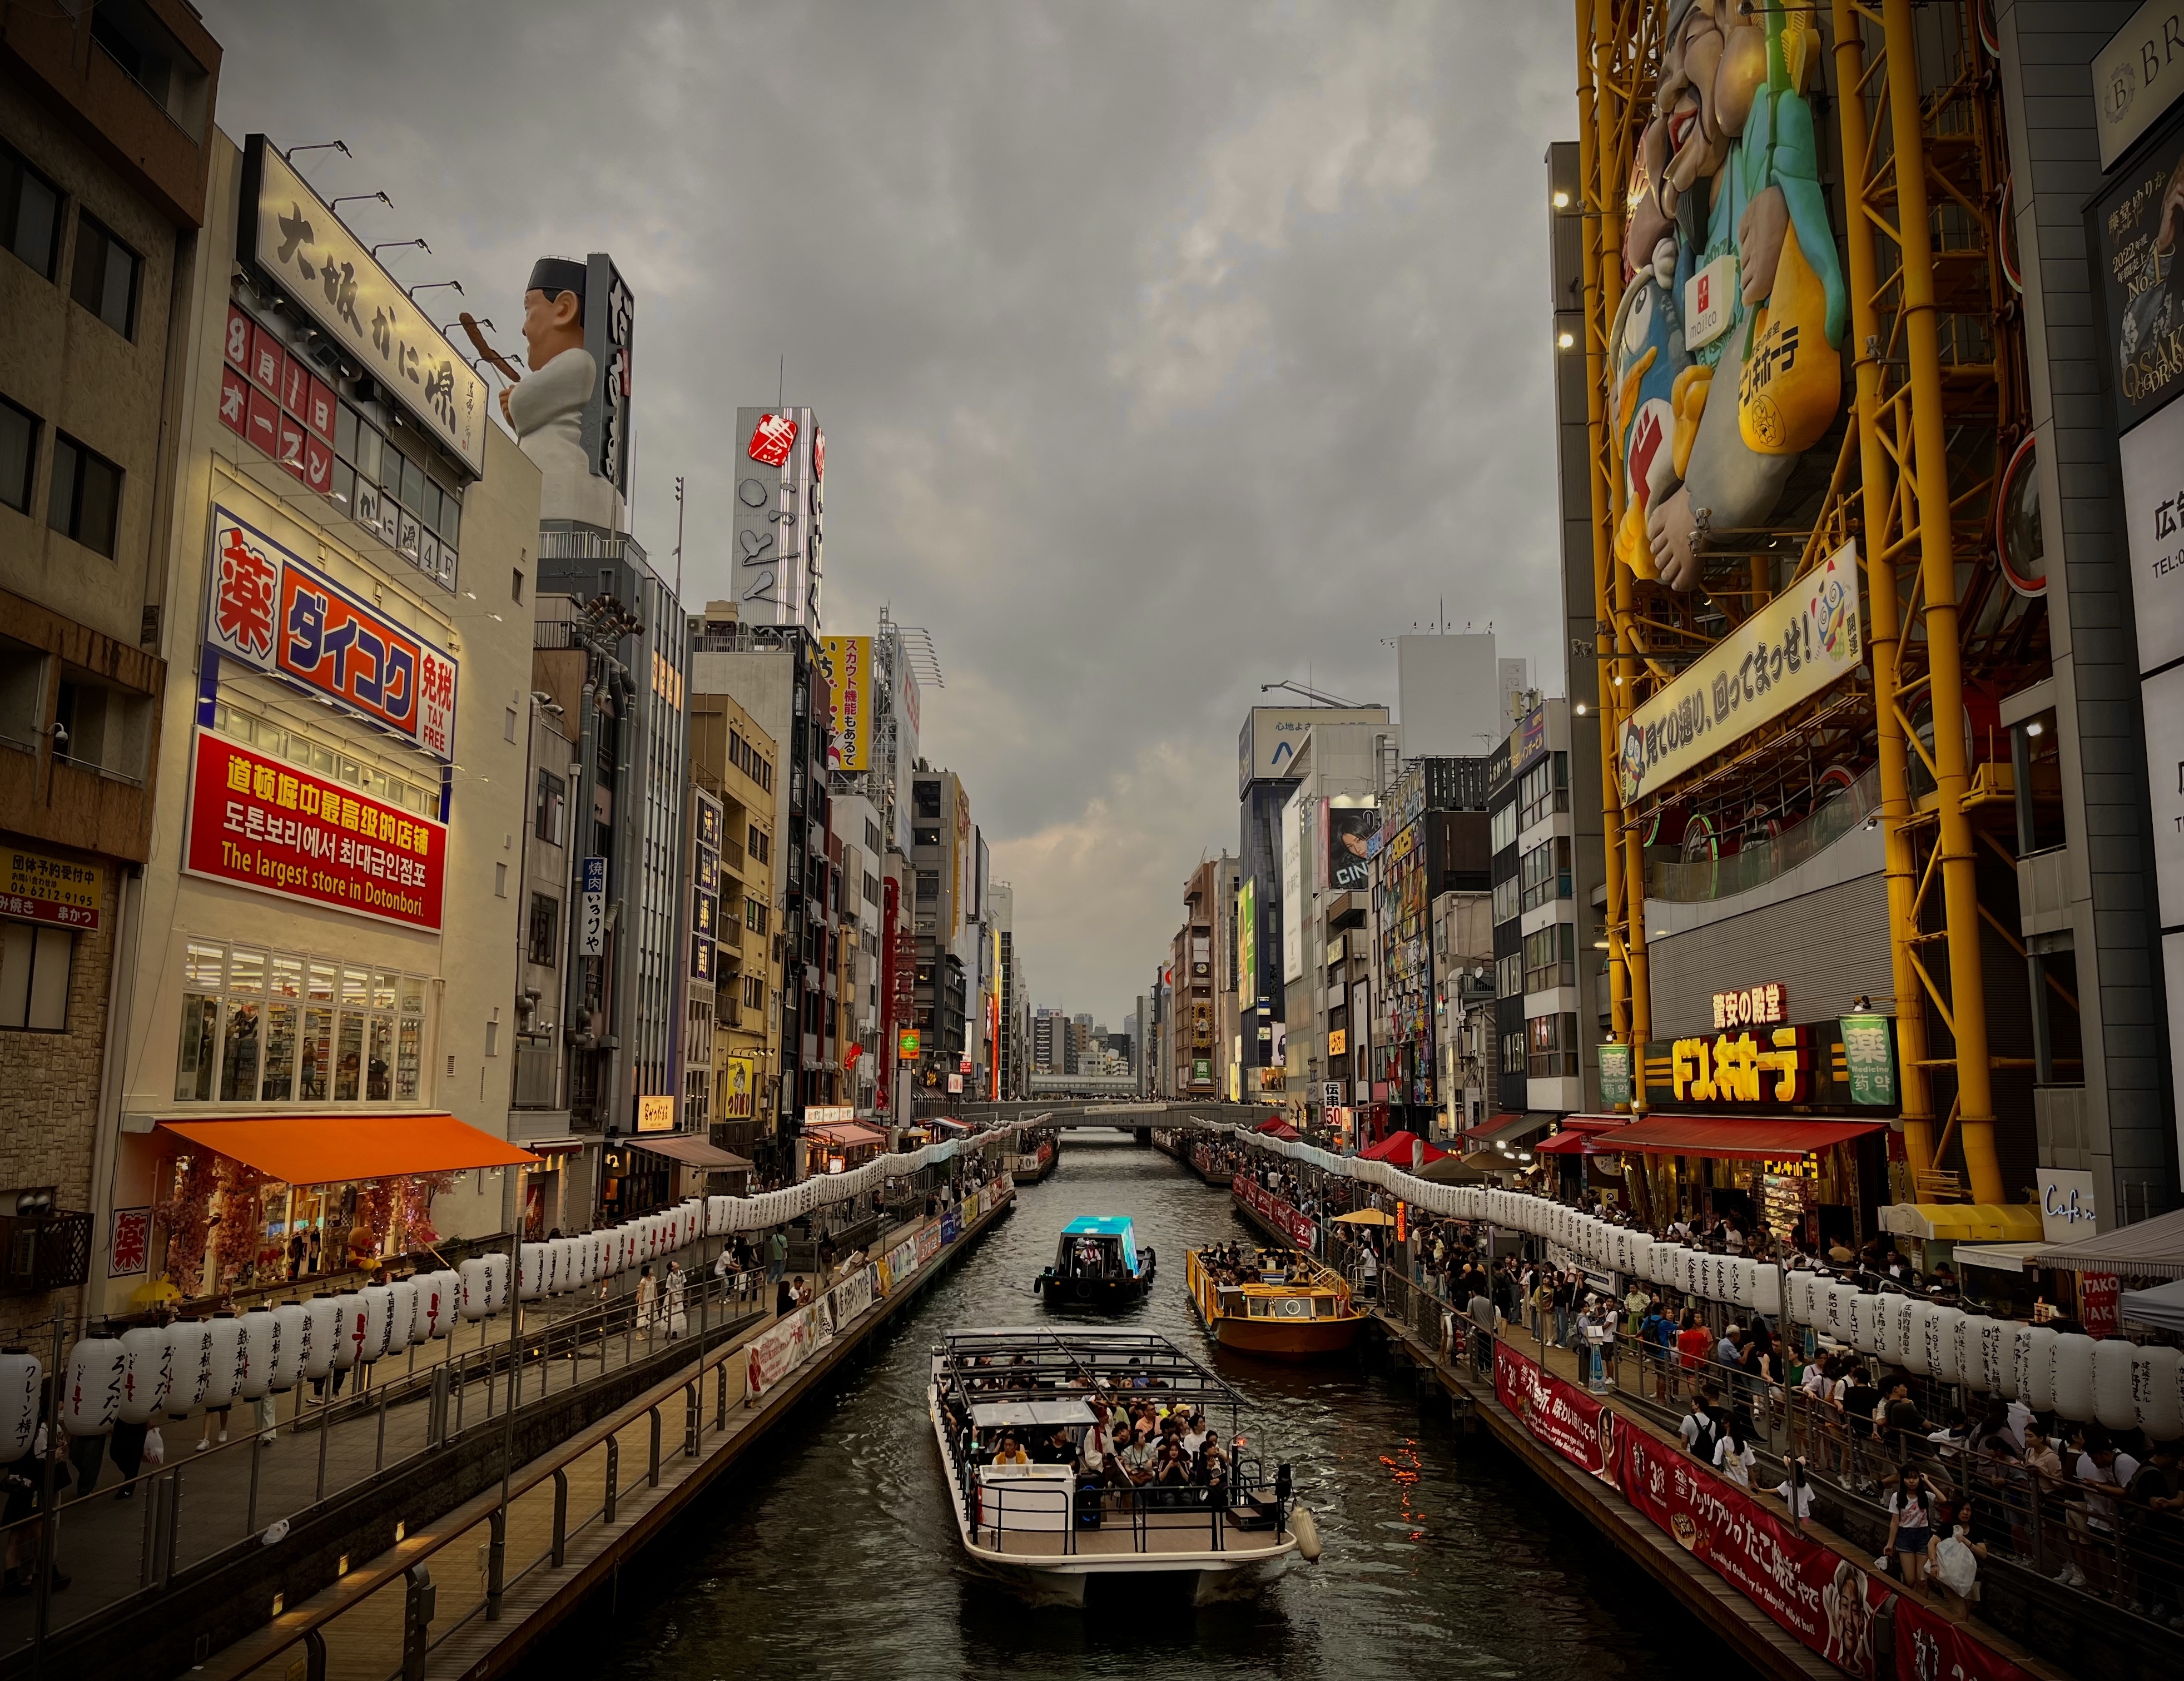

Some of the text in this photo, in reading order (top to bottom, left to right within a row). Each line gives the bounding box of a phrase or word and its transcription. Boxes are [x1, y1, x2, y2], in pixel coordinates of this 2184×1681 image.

[2113, 233, 2148, 273] 2022年度
[228, 317, 330, 431] 8月1日
[221, 384, 328, 485] オープン
[360, 493, 419, 558] かに源
[219, 525, 277, 660] 薬
[288, 585, 416, 722] ダイコク
[422, 652, 451, 714] 免税
[844, 639, 858, 766] スカウト機能もあるで
[423, 724, 446, 753] FREE
[427, 704, 445, 729] TAX
[227, 753, 430, 857] 道顿堀中最高级的店铺
[223, 800, 426, 889] 도톤보리에서 최대급인점포
[11, 872, 57, 888] お問い合わせは
[12, 854, 95, 886] 団体予約受付中
[222, 841, 425, 918] The largest store in Dotonbori.
[10, 883, 93, 908] 06-6212-9195
[57, 908, 92, 925] 串かつ
[585, 861, 603, 953] 焼肉 いろりや
[1713, 983, 1781, 1030] 驚安の殿堂
[1602, 1053, 1627, 1077] 薬
[1848, 1028, 1887, 1064] 薬
[1326, 1083, 1341, 1125] 伝串 50
[1617, 1083, 1629, 1096] 약
[1853, 1075, 1870, 1091] 药
[1874, 1073, 1890, 1092] 약
[2045, 1183, 2082, 1224] Cafe
[115, 1212, 146, 1272] 薬
[2084, 1276, 2119, 1294] TAKO
[14, 1366, 36, 1448] クレーン横丁
[98, 1355, 125, 1426] ろくだん
